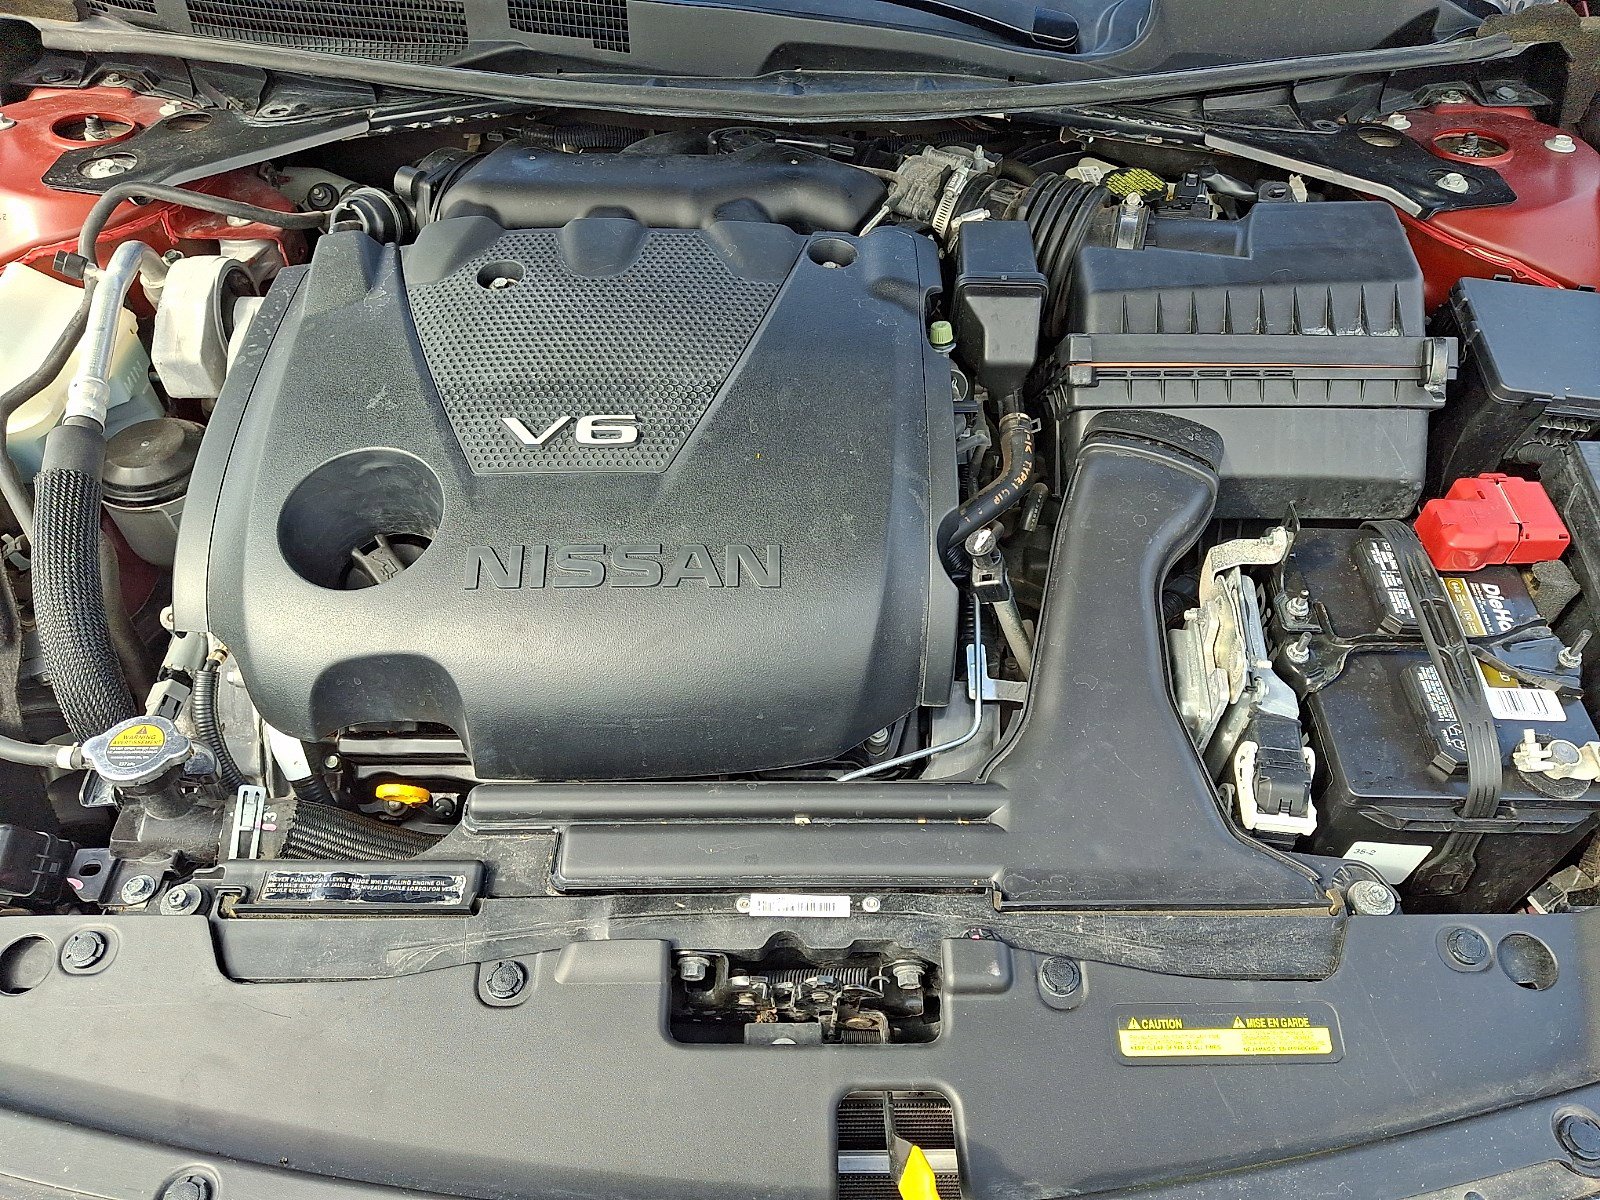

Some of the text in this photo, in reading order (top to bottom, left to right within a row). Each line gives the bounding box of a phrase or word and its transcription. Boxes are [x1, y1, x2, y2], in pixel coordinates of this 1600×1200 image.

[501, 414, 639, 446] V6
[464, 543, 781, 590] NISSAN
[1481, 582, 1515, 632] DieHa
[1141, 1019, 1183, 1029] CAUTION
[1246, 1017, 1311, 1028] MISE EN GARDE
